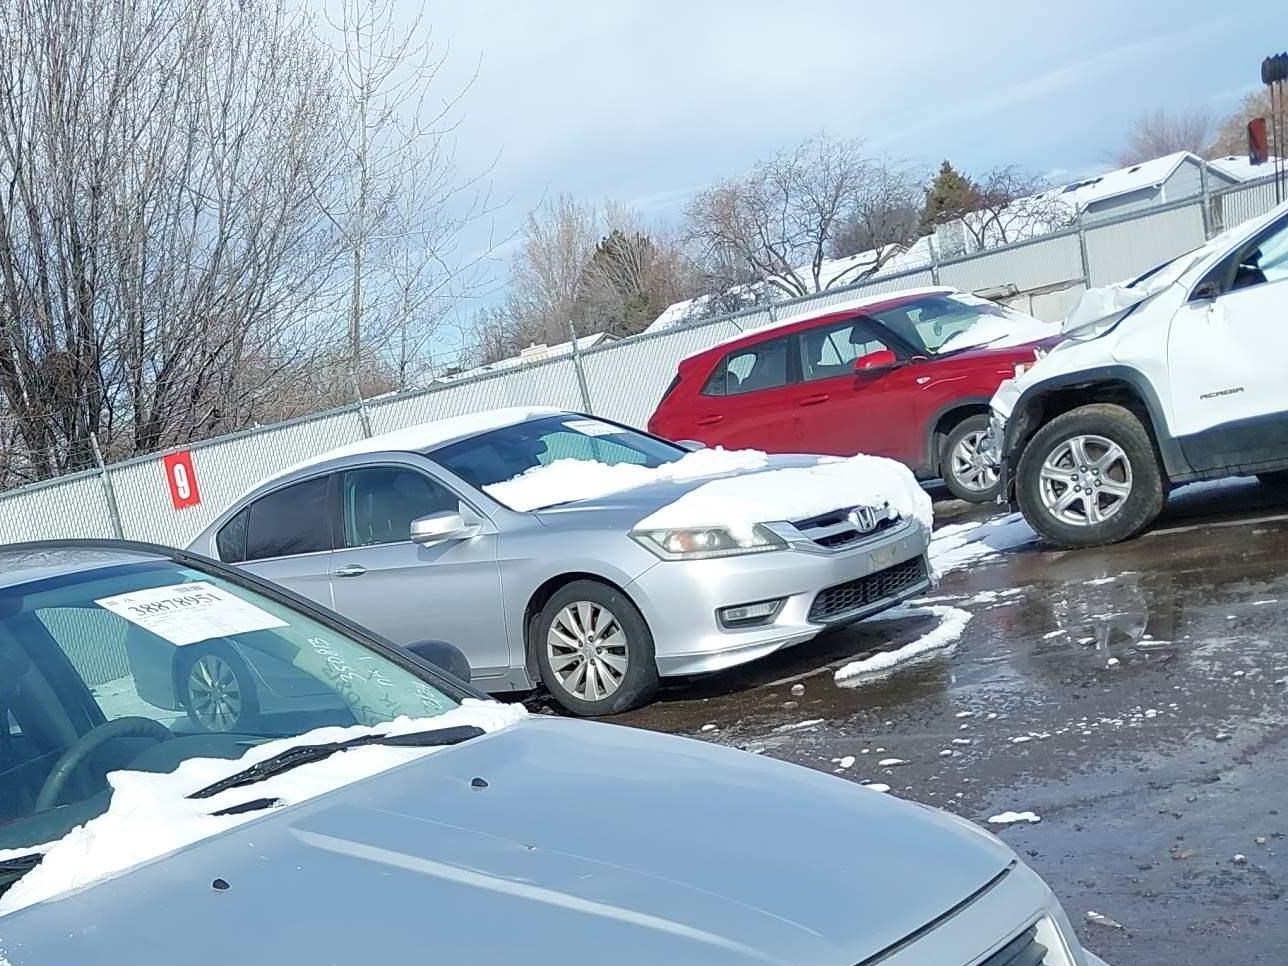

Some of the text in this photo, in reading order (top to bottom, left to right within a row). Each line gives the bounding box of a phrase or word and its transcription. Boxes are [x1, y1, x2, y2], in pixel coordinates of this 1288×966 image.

[1199, 387, 1245, 400] ACADIA
[173, 463, 191, 500] 9
[128, 592, 223, 617] 38878951
